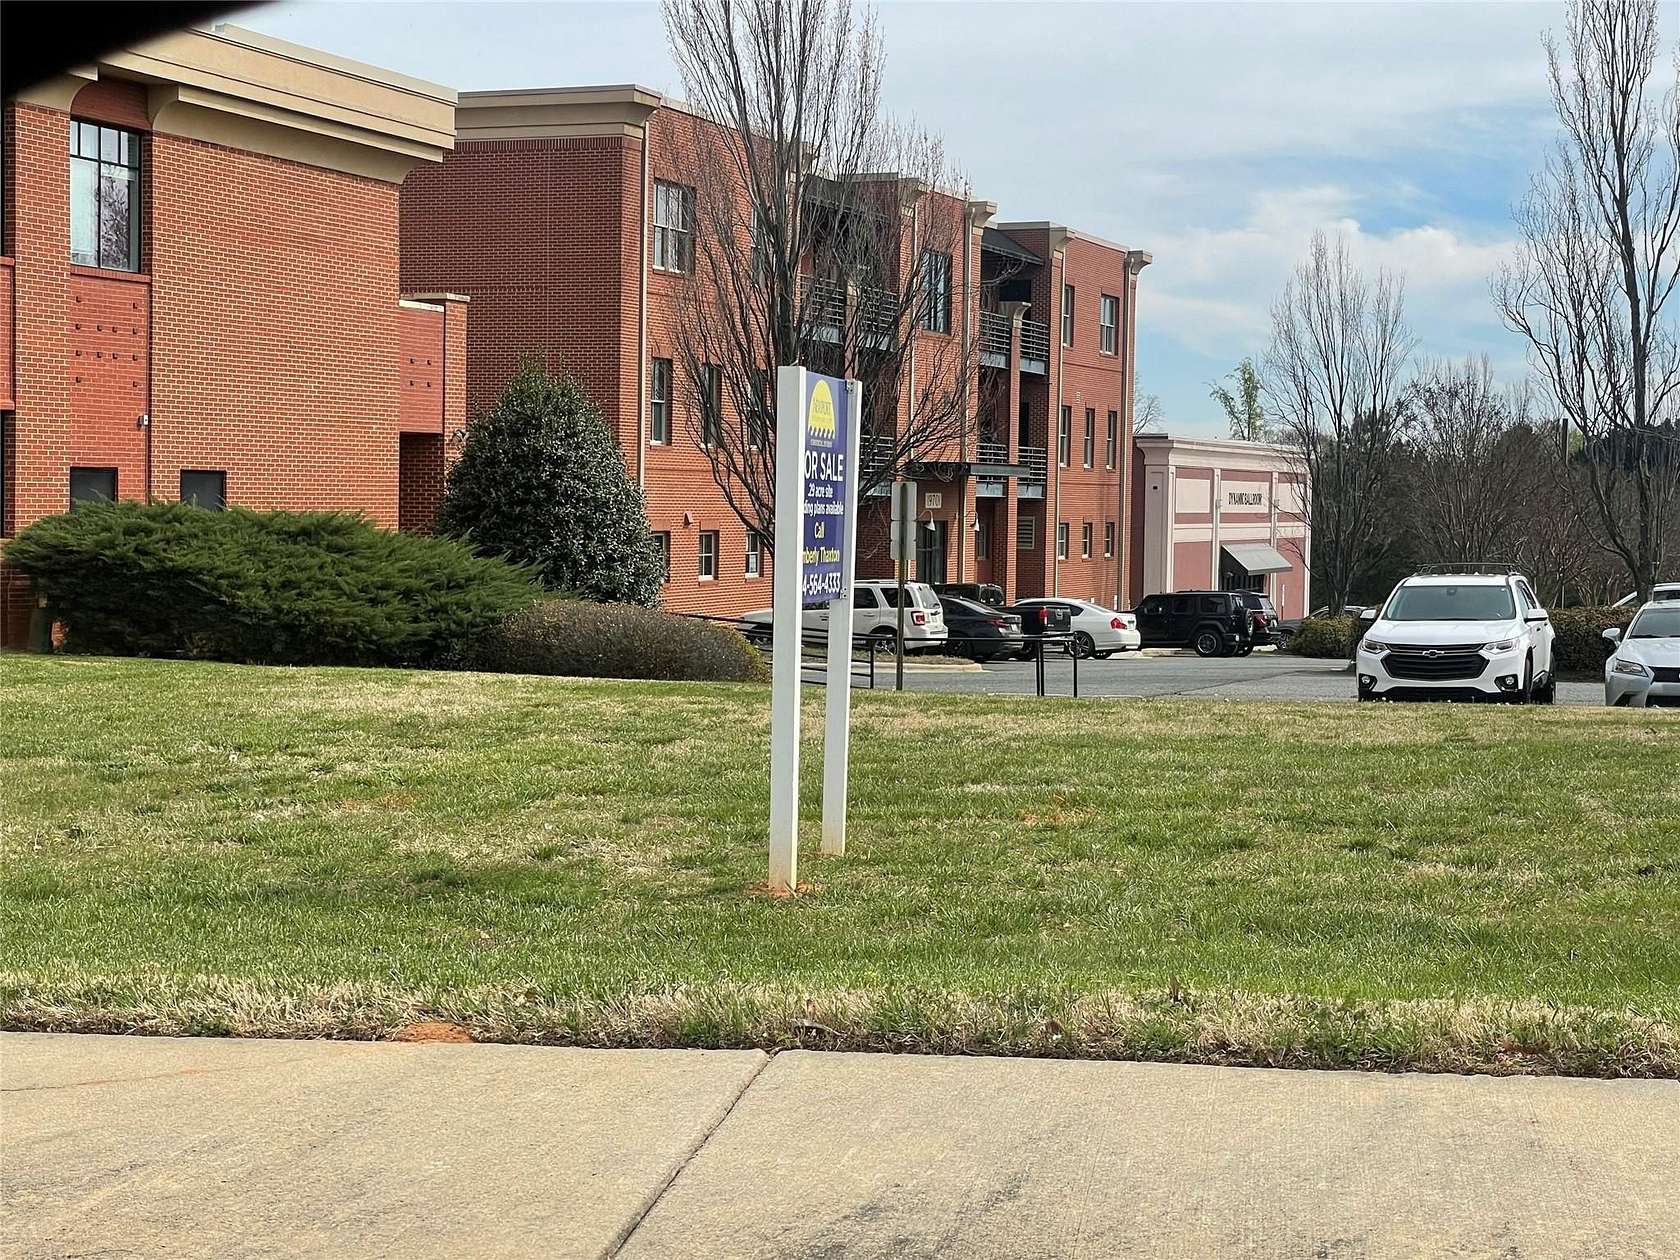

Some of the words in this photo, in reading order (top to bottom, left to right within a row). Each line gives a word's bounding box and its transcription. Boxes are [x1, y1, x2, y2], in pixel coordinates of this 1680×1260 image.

[804, 450, 818, 479] OR
[820, 452, 844, 482] SALE
[803, 499, 814, 516] ding
[825, 500, 844, 515] available
[814, 521, 825, 539] Call
[802, 546, 819, 566] mberly
[802, 572, 841, 597] 4-564-4333
